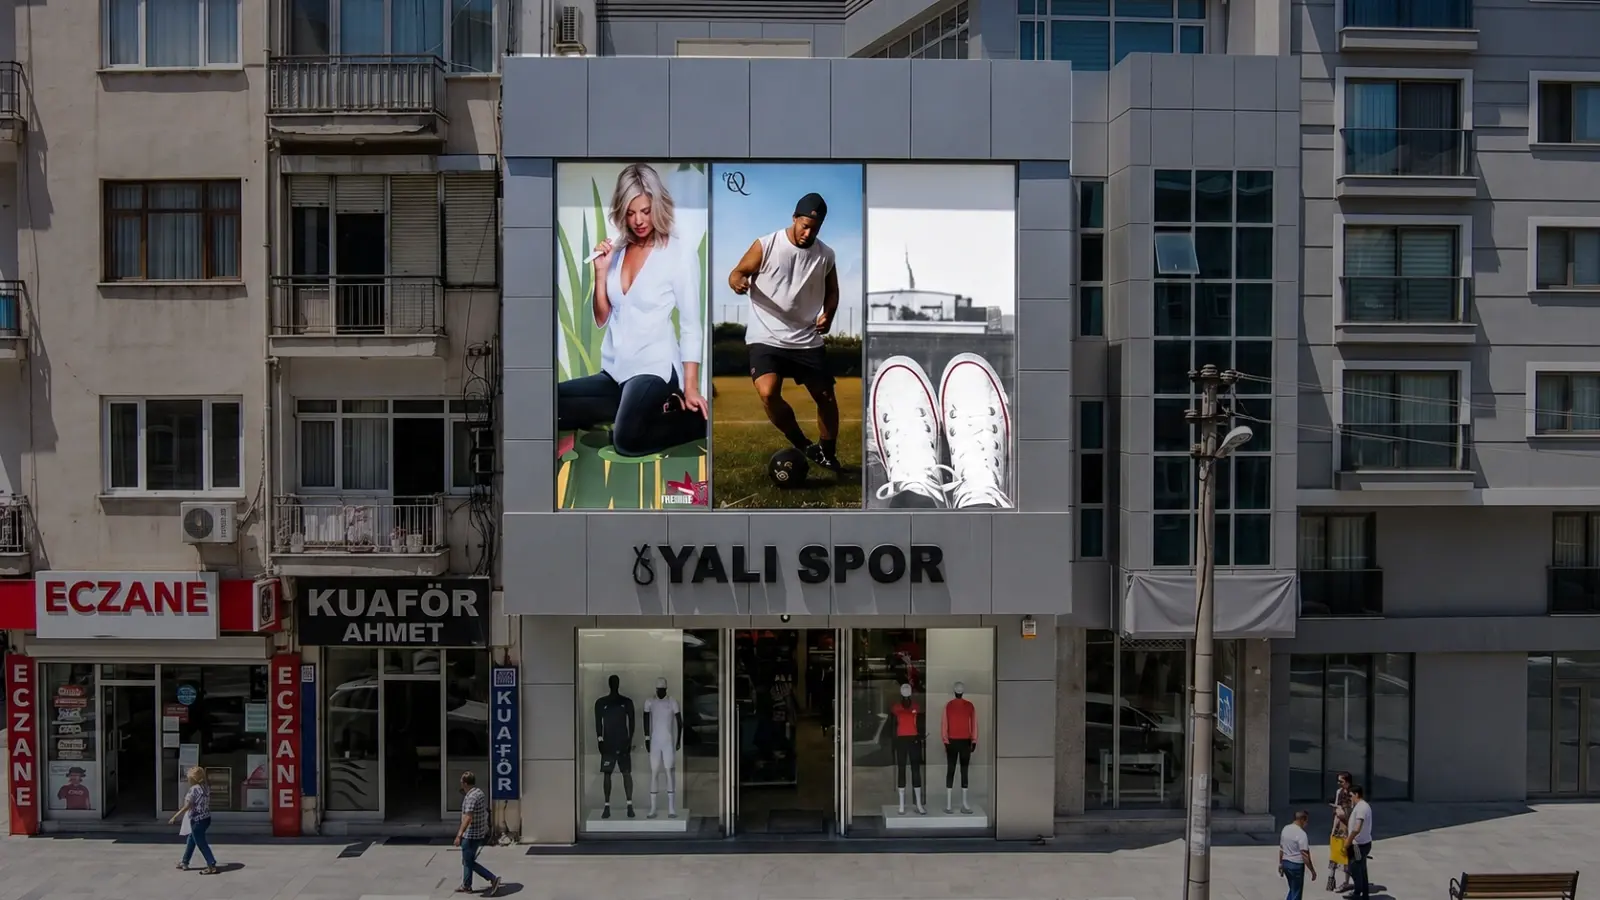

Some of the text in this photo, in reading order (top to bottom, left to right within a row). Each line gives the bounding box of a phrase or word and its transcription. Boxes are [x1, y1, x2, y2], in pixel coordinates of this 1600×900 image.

[657, 543, 944, 585] YALI SPOR
[45, 581, 209, 614] ECZANE
[308, 583, 479, 617] KUAFÖR
[342, 622, 444, 642] AHMET
[13, 664, 32, 806] ECZANE
[276, 666, 296, 808] ECZANE
[496, 691, 513, 791] KUAFÖR
